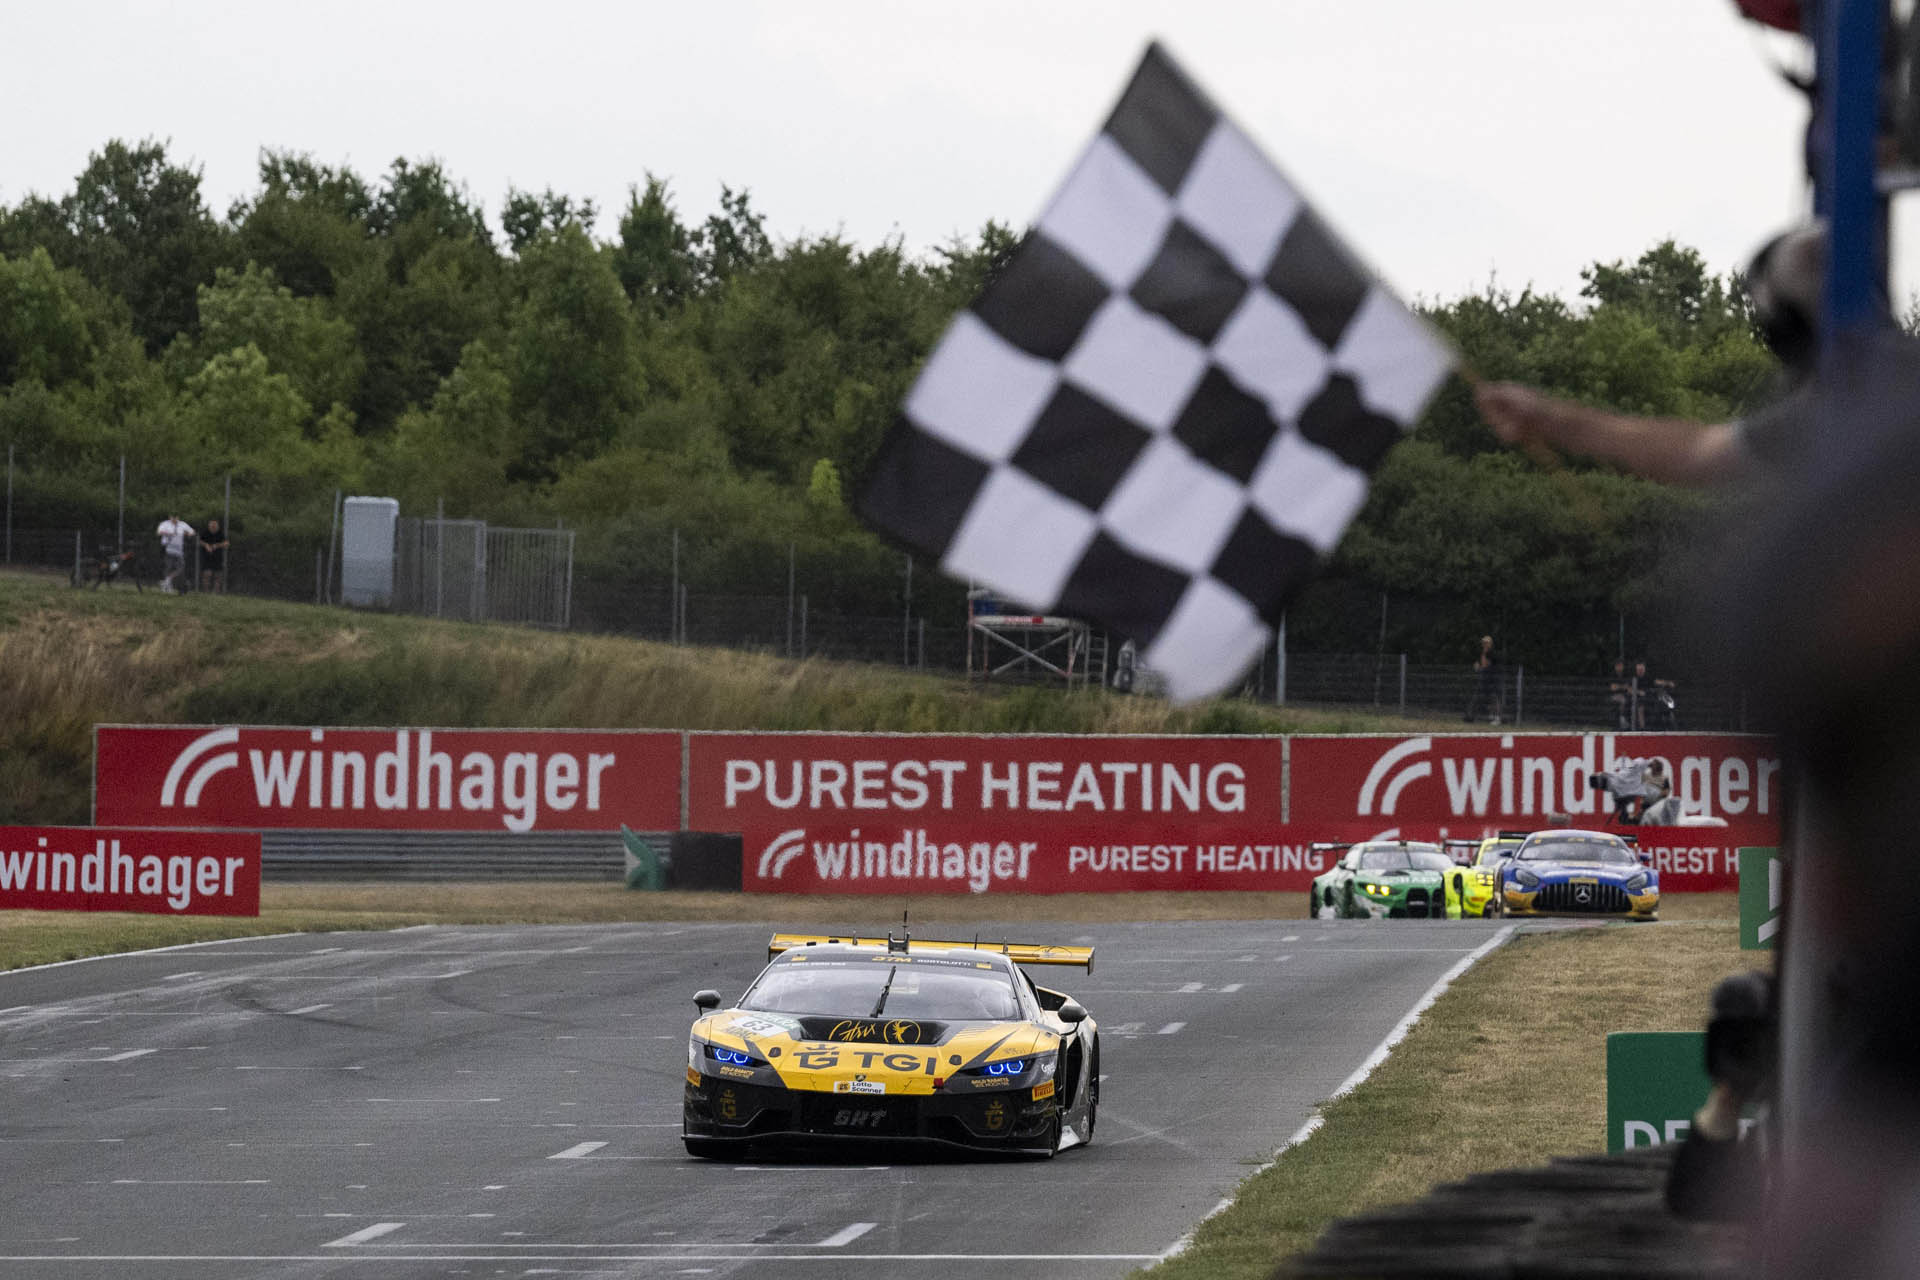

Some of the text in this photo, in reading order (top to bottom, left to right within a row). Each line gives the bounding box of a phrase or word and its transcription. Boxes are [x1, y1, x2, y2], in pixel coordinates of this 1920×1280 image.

[249, 728, 615, 832] windhager
[724, 760, 1246, 812] PUREST HEATING
[0, 838, 244, 910] windhager
[813, 828, 1037, 894] windhager
[1068, 845, 1323, 873] PUREST HEATING
